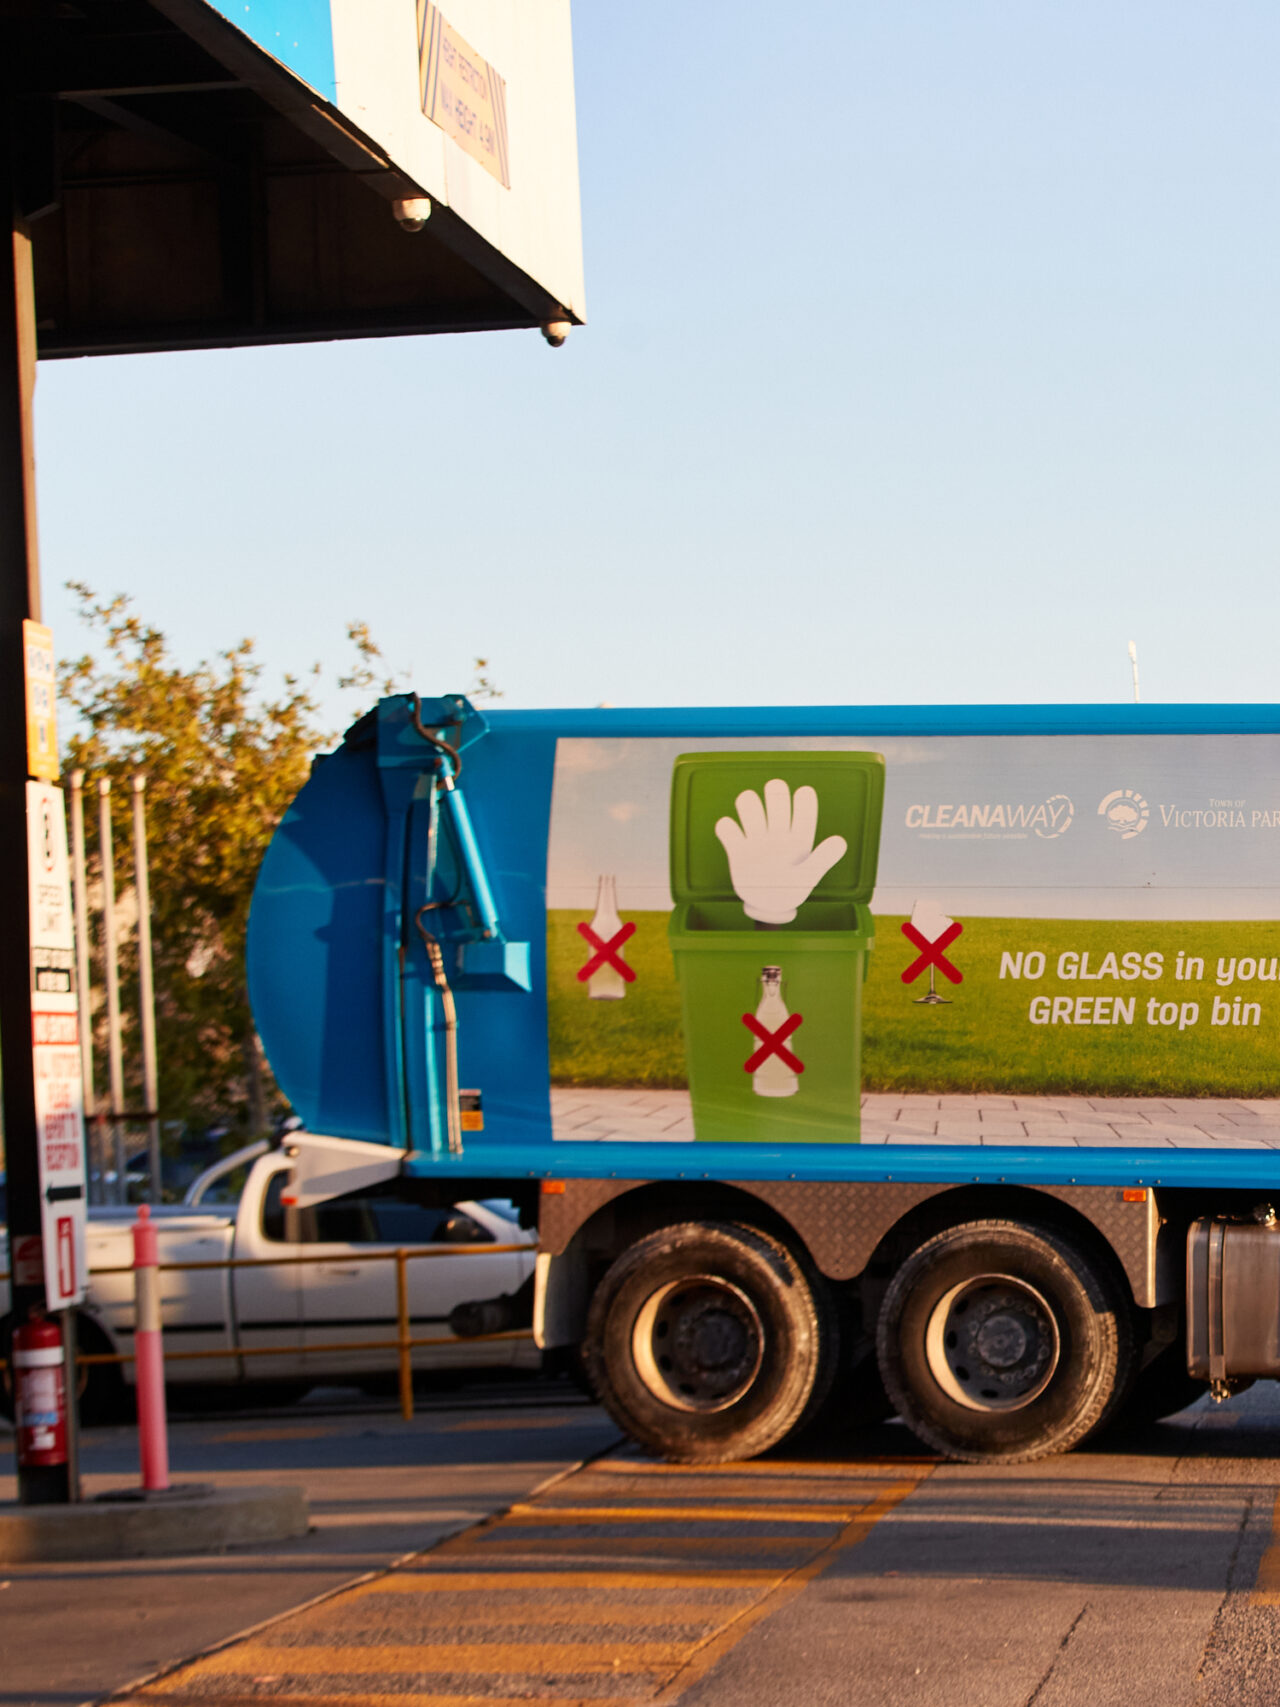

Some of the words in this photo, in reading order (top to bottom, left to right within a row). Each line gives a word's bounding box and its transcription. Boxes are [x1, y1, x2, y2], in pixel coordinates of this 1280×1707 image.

[905, 804, 1065, 828] CLEANAWAY
[1159, 804, 1246, 828] VICTORIA
[999, 951, 1046, 980] NO
[1057, 951, 1163, 981] GLASS
[1175, 951, 1204, 980] in
[1029, 996, 1136, 1026] GREEN
[1147, 998, 1198, 1030] top
[1211, 996, 1262, 1026] bin
